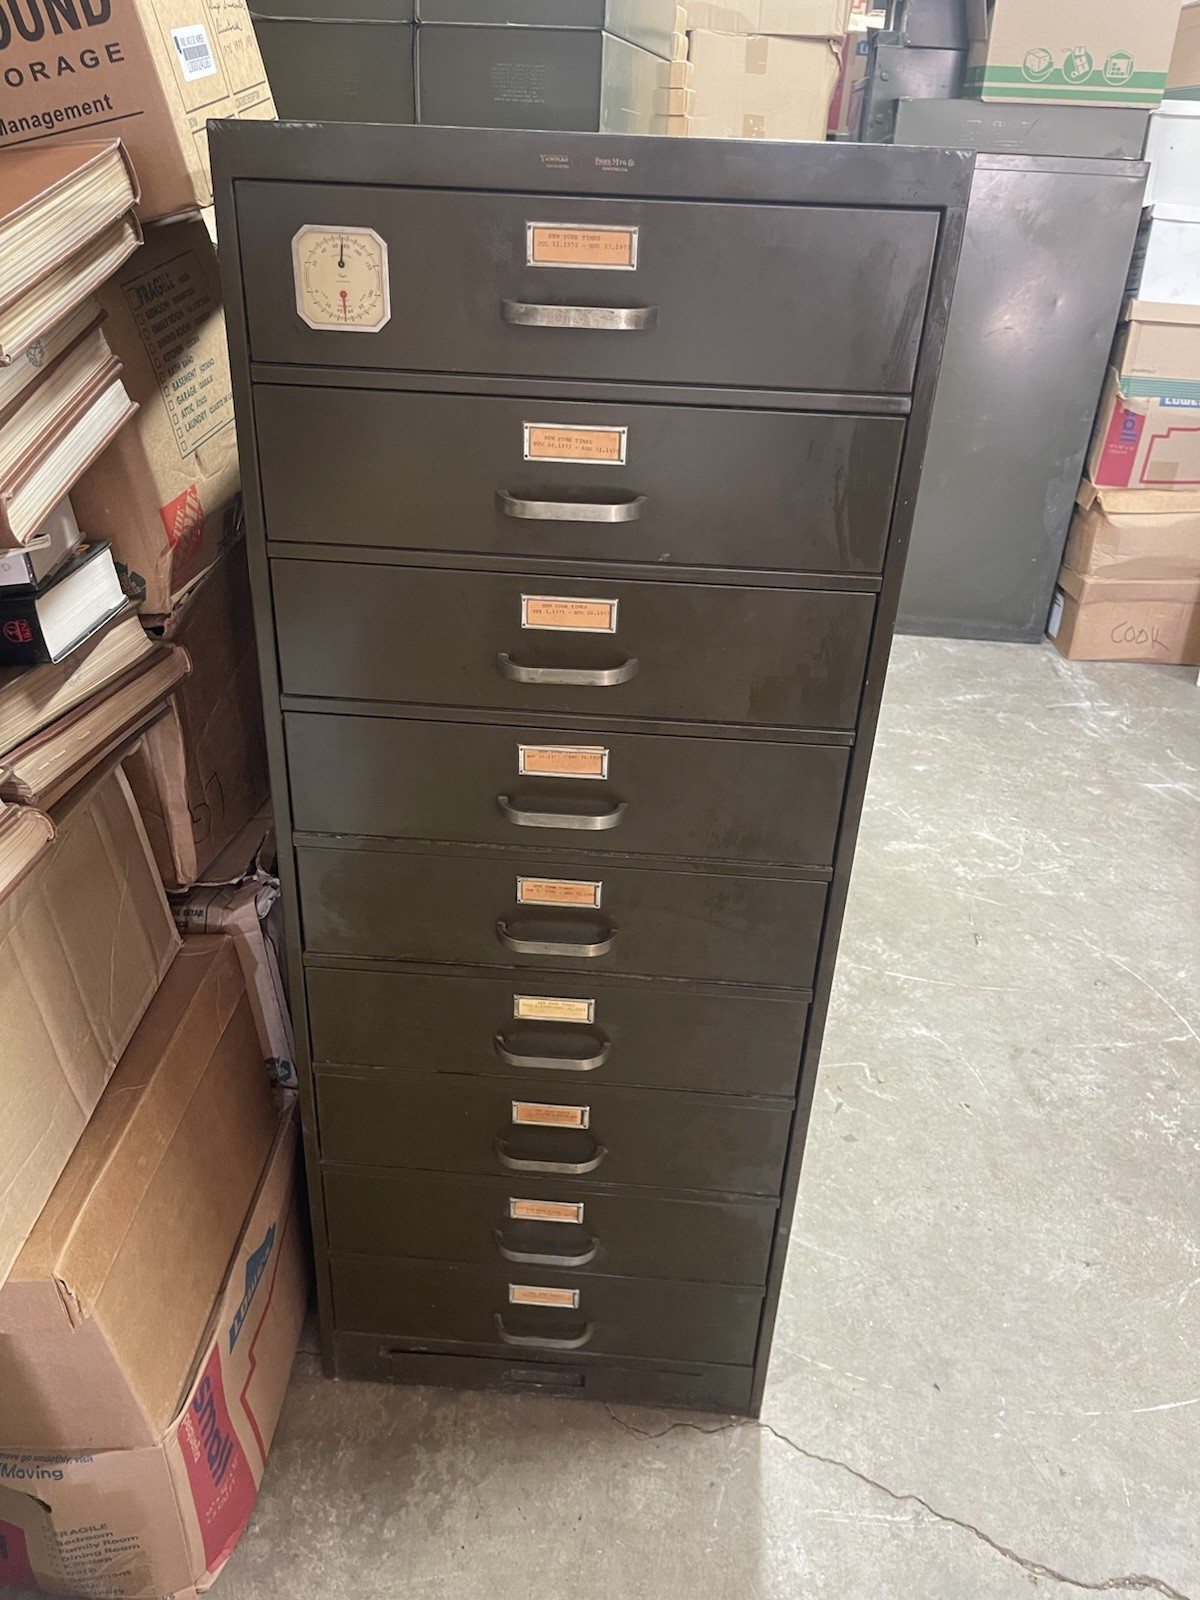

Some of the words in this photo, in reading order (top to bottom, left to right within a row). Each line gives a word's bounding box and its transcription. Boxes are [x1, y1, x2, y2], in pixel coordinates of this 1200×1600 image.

[4, 42, 125, 87] ORAGE
[1111, 621, 1169, 651] COOK
[20, 1454, 32, 1462] go
[103, 1535, 140, 1546] Room
[104, 1544, 140, 1554] Room
